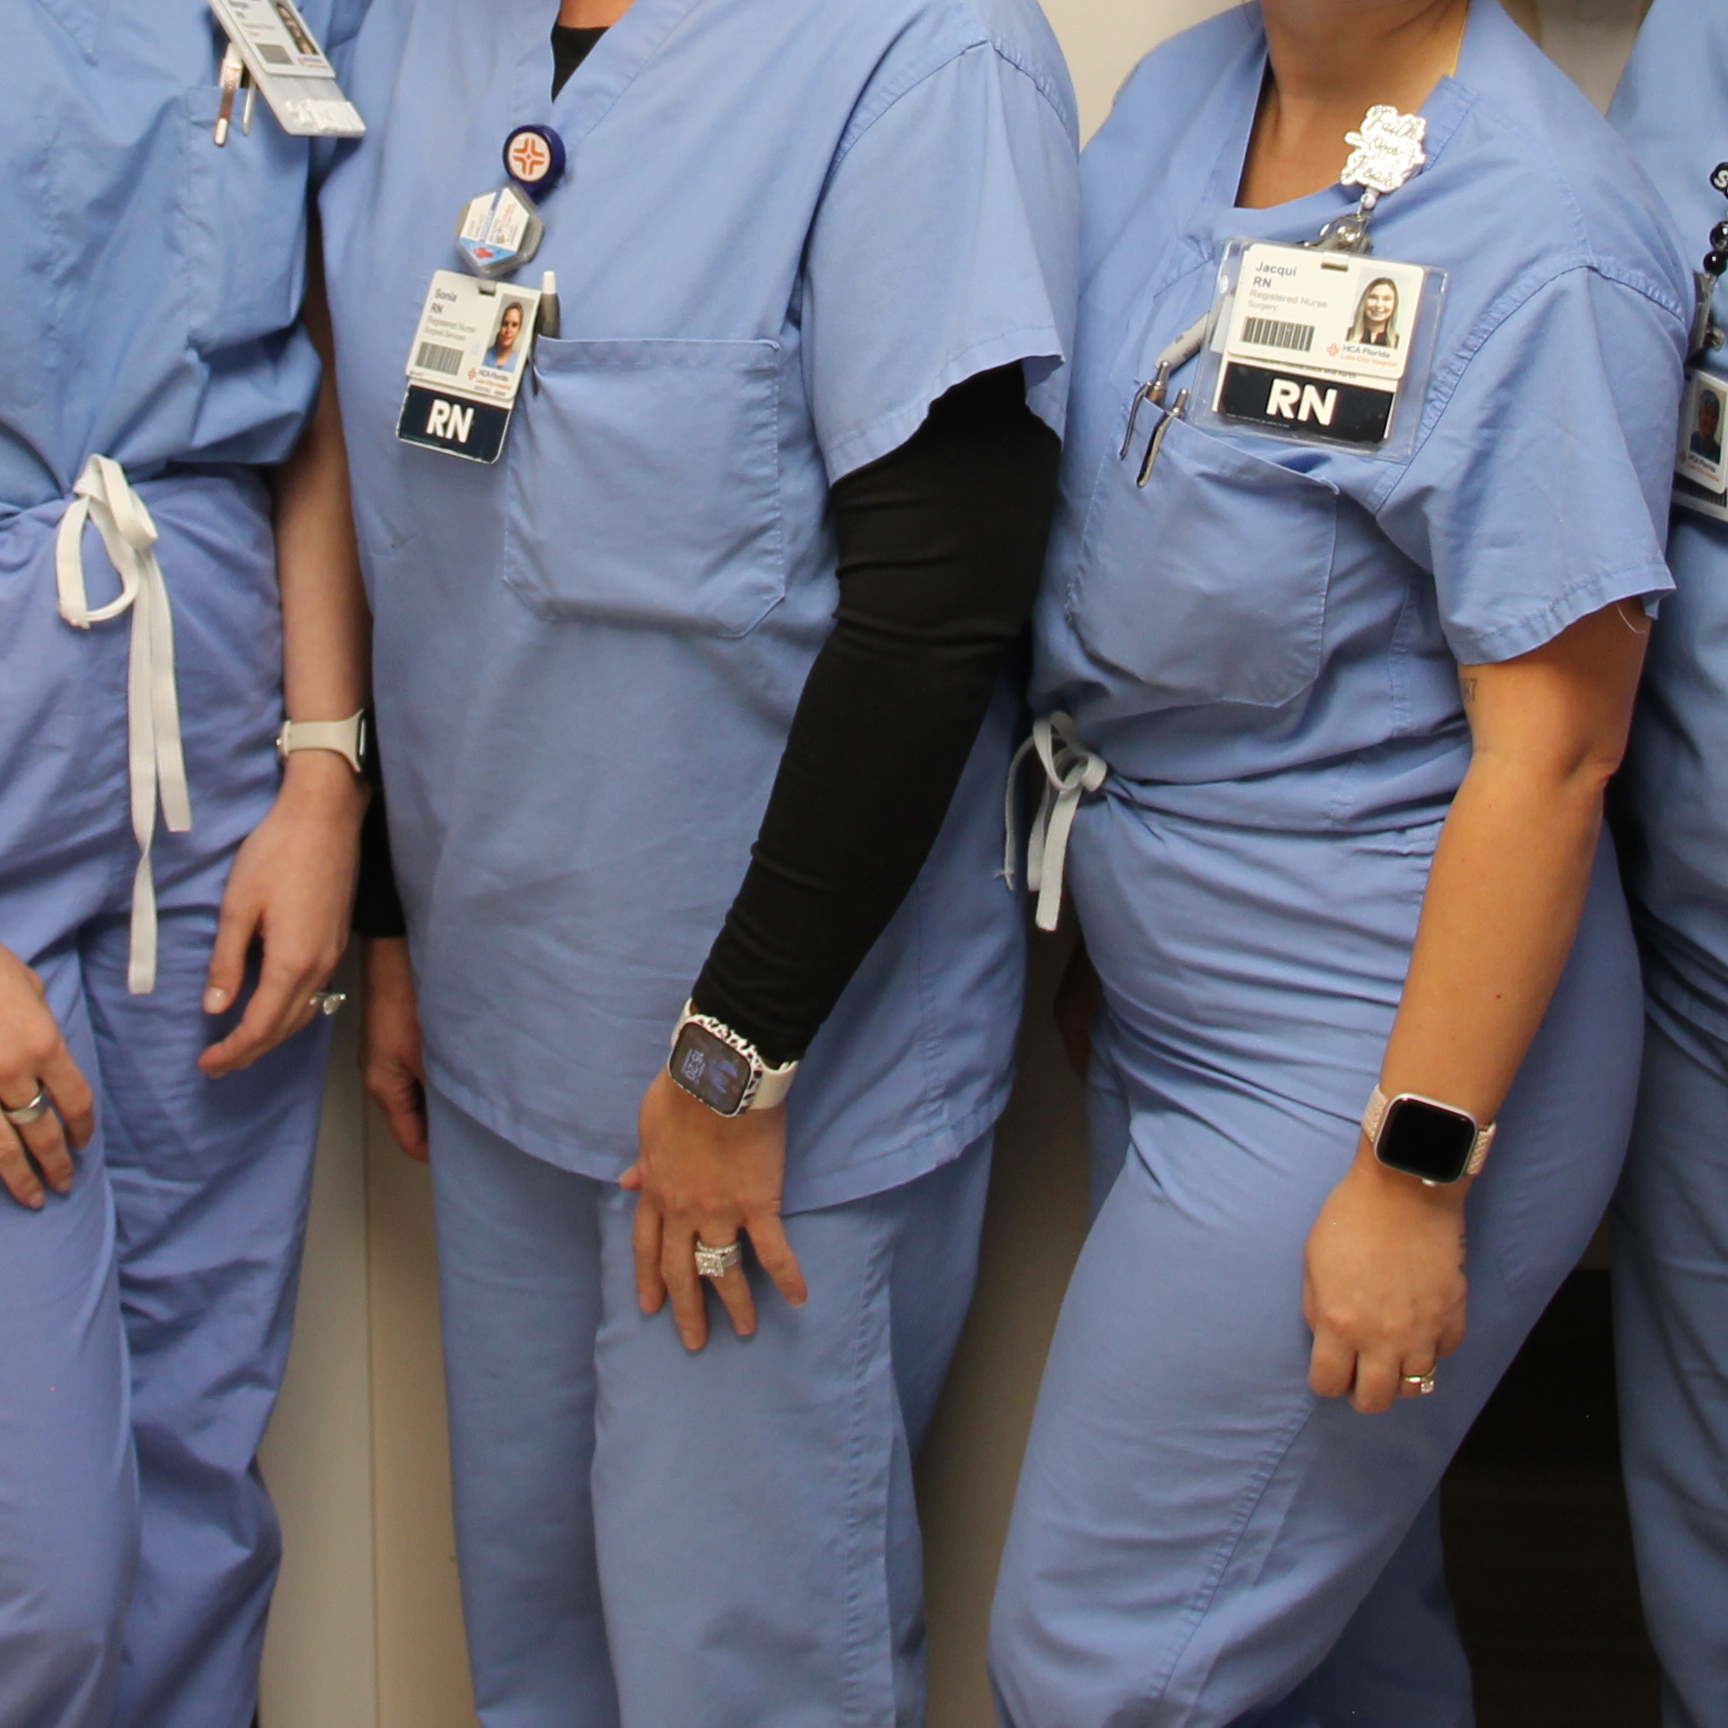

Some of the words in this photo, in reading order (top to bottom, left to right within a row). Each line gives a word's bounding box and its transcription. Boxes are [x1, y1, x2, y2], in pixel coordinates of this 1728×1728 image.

[1255, 261, 1298, 278] Jacqui
[1252, 276, 1272, 288] RN
[434, 288, 458, 302] Sonia
[1249, 288, 1299, 304] Registered
[1300, 295, 1328, 309] Nurse
[430, 302, 444, 314] RN
[1247, 299, 1279, 312] Surgery
[1342, 344, 1361, 354] HCA
[1361, 347, 1391, 358] Florida
[1265, 377, 1339, 426] RN
[425, 398, 475, 443] RN
